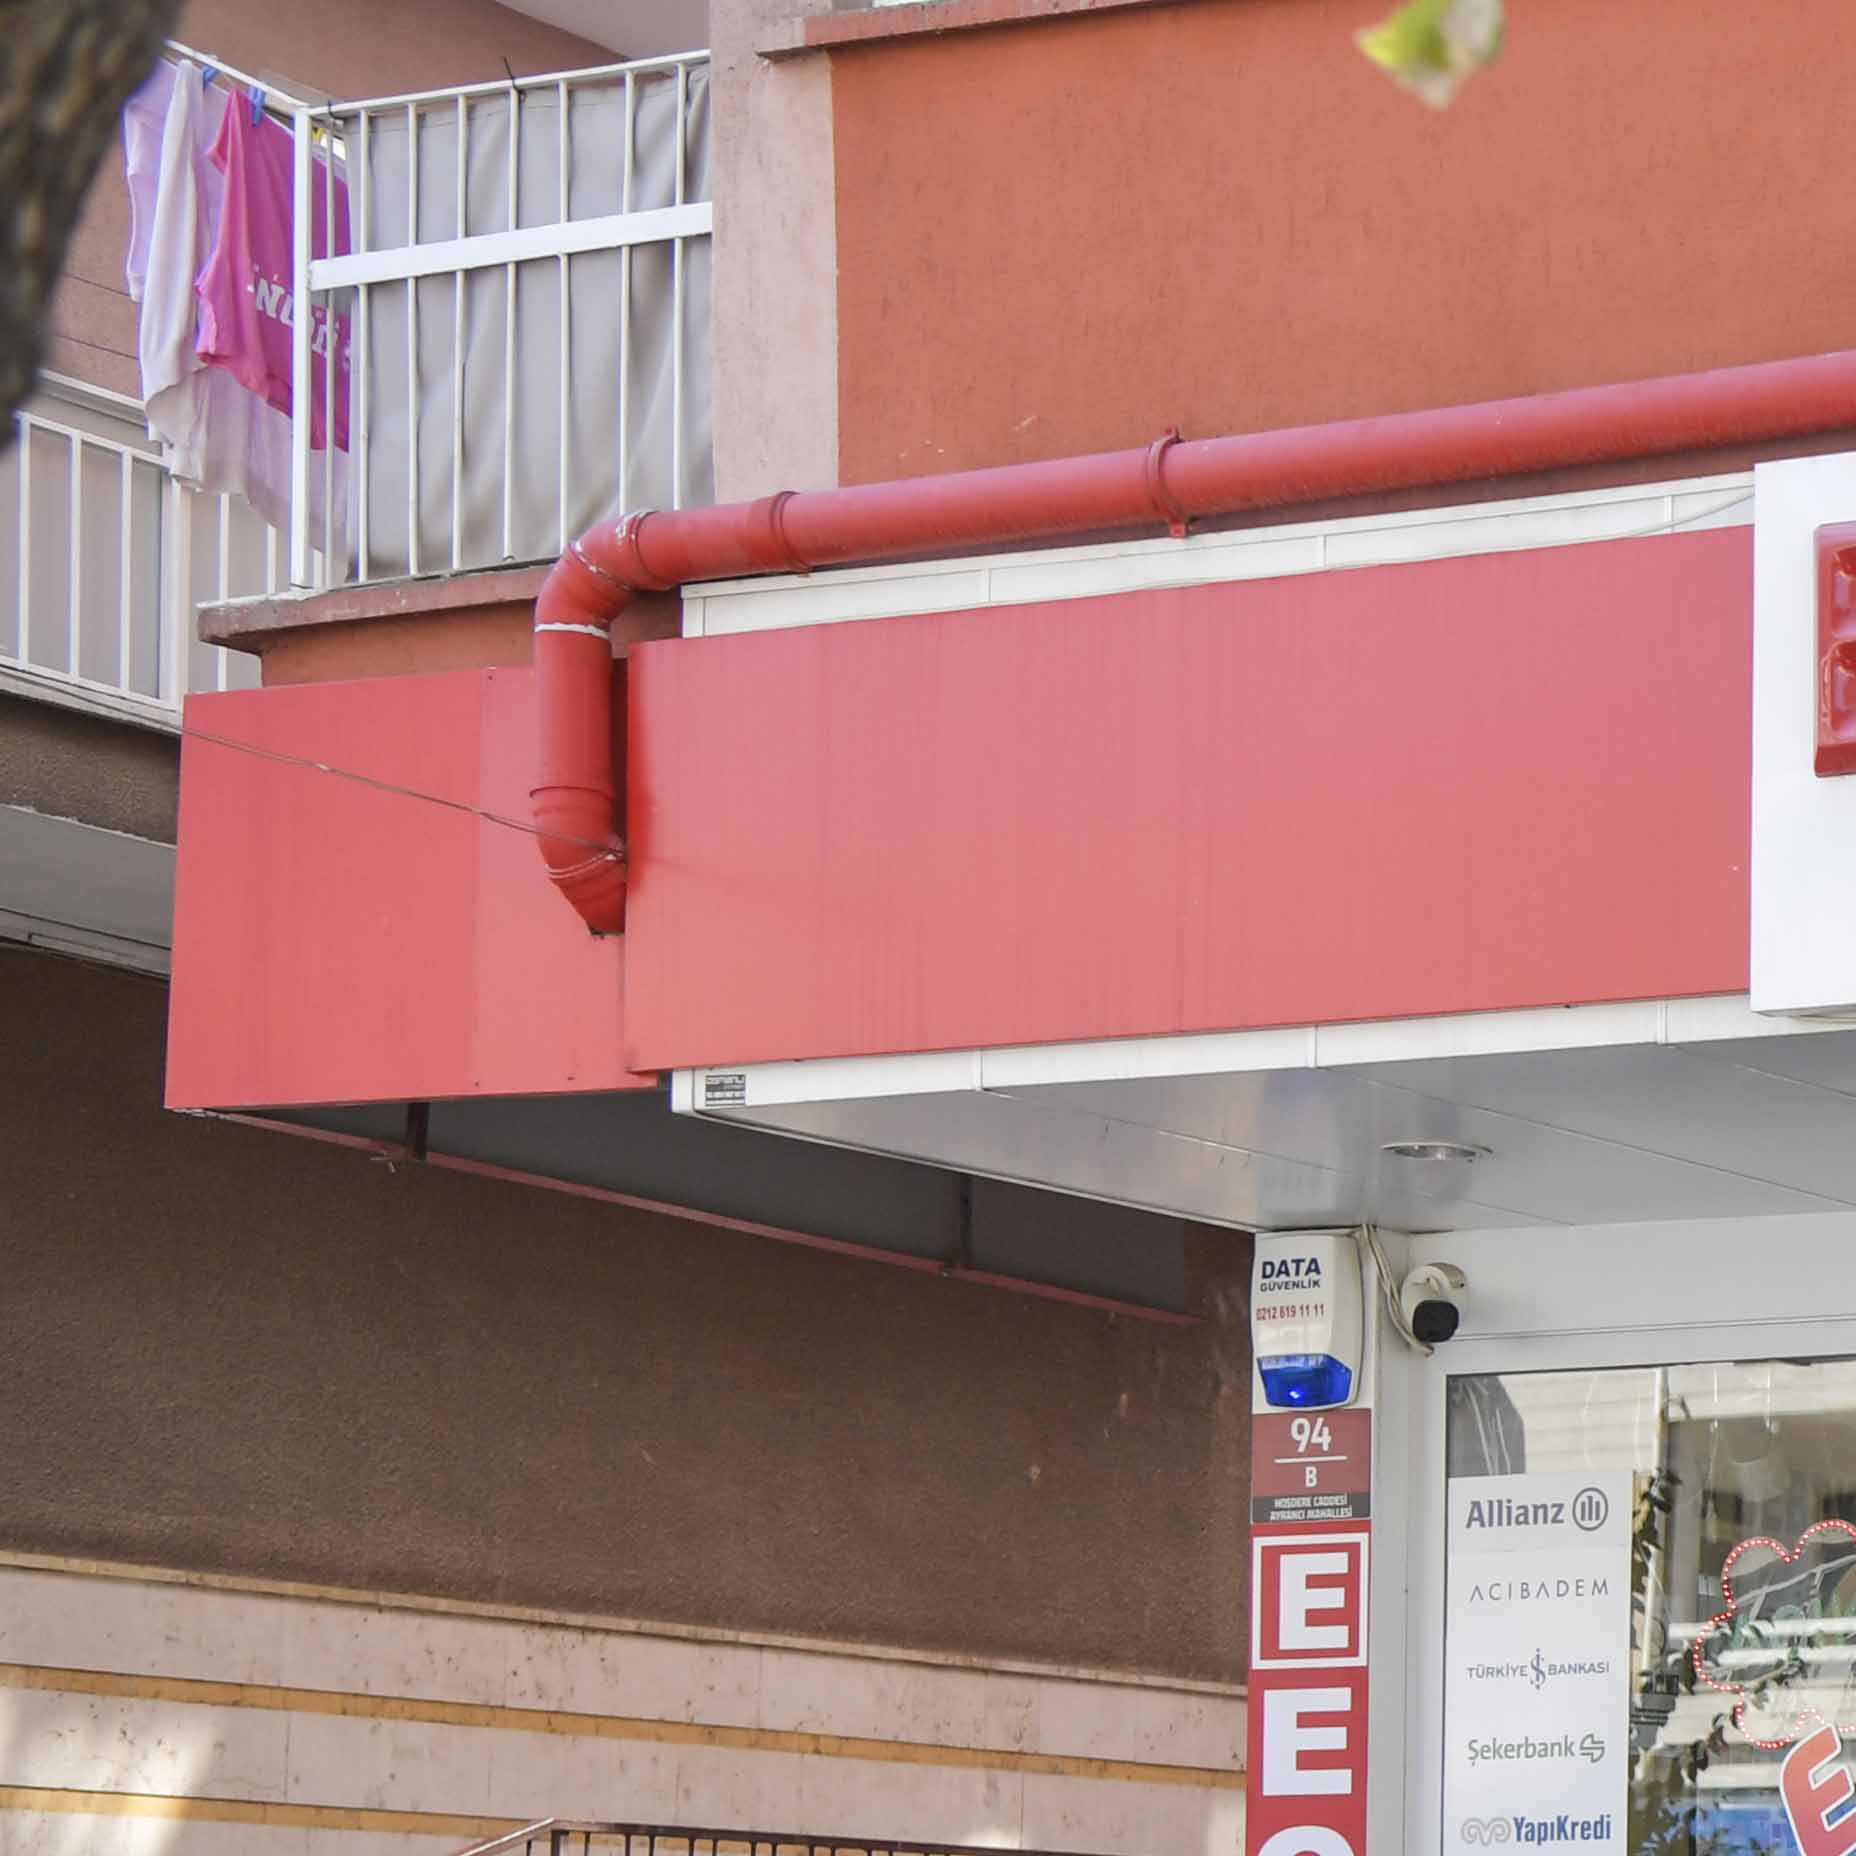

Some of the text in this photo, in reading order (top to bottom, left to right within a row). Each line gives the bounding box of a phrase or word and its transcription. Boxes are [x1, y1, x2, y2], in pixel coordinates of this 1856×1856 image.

[1261, 1257, 1321, 1279] DATA
[1260, 1278, 1321, 1292] GÜVENLİK
[1290, 1417, 1331, 1453] 94
[1305, 1466, 1317, 1488] B
[1466, 1499, 1564, 1529] Allianz
[1278, 1551, 1349, 1650] E
[1470, 1578, 1609, 1602] ACIBADEM
[1467, 1660, 1610, 1680] TÜRKİYE BANKASI
[1467, 1734, 1576, 1767] Şekerbank
[1513, 1814, 1612, 1845] YapıKredi
